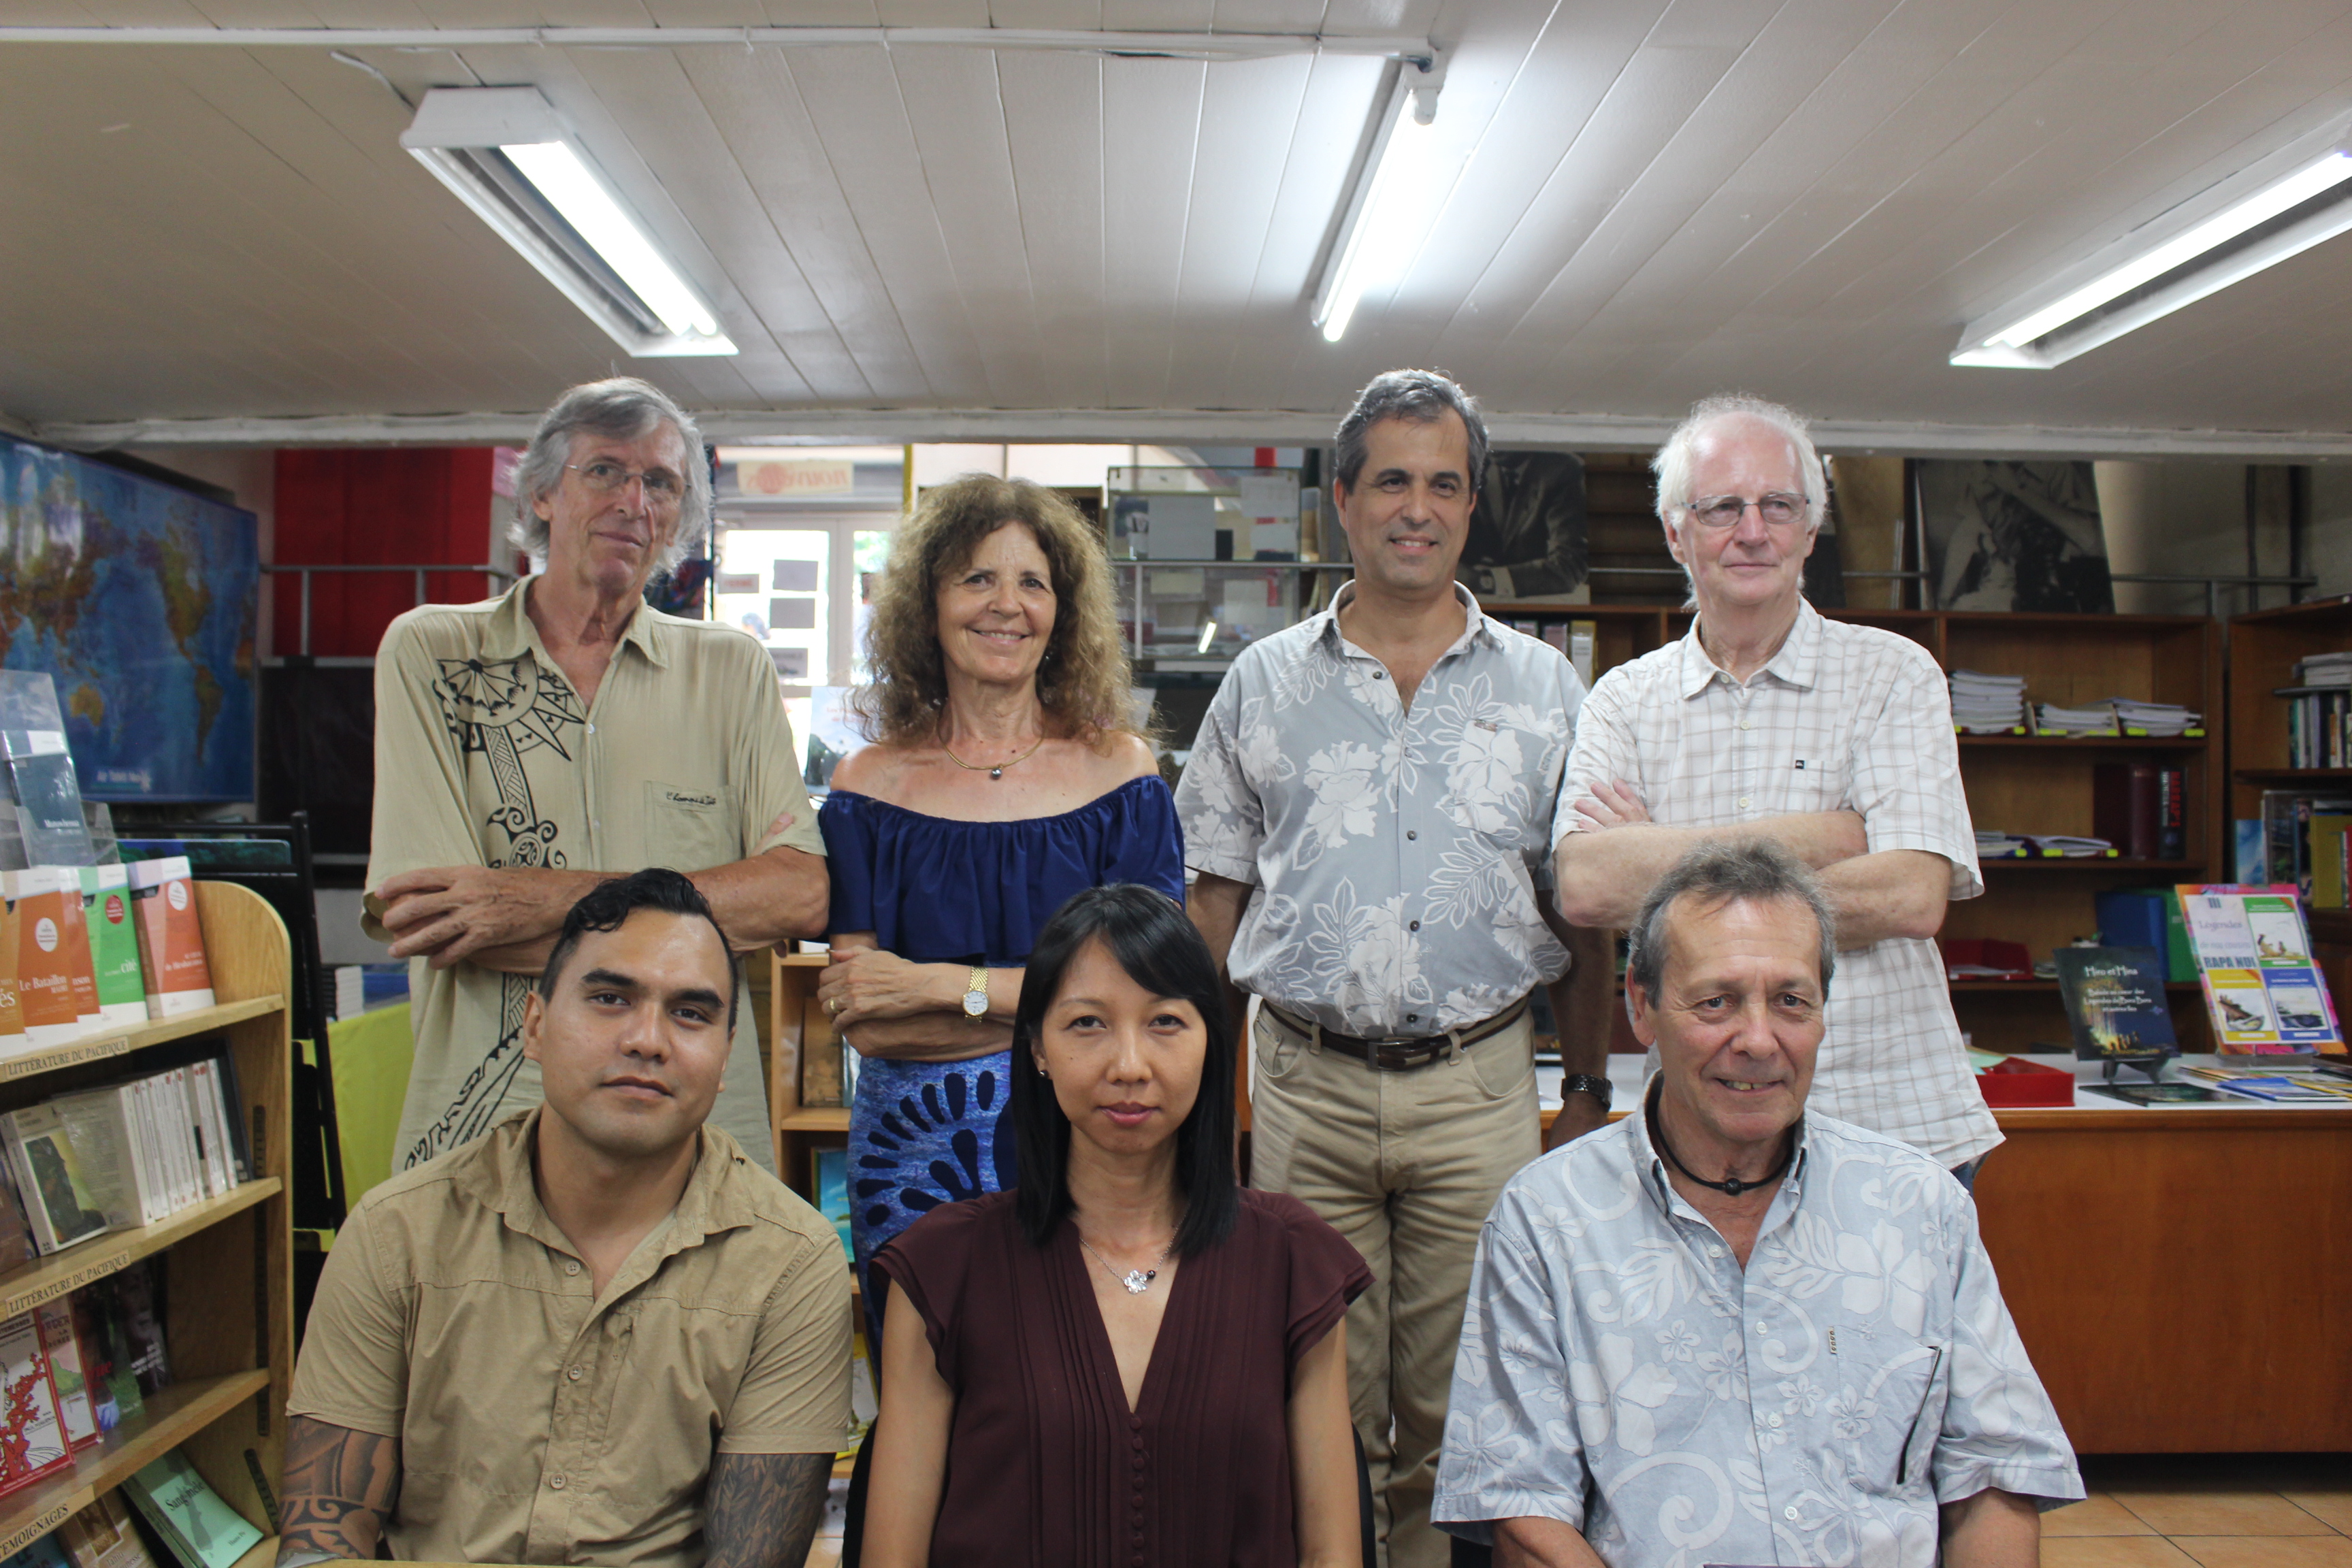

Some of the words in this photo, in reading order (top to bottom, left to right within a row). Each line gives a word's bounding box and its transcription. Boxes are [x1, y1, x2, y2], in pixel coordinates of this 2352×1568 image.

[2204, 956, 2235, 968] RAPA
[2235, 956, 2257, 968] NUI
[2107, 968, 2115, 976] et
[19, 979, 31, 991] Le
[33, 974, 67, 989] Bataillon
[9, 1052, 70, 1075] LITTÉRATURE
[72, 1049, 84, 1061] DU
[86, 1041, 127, 1058] PACIFIQUE
[10, 1277, 71, 1313] LITTÉRATURE
[73, 1271, 86, 1285] DU
[86, 1254, 128, 1279] PACIFIQUE
